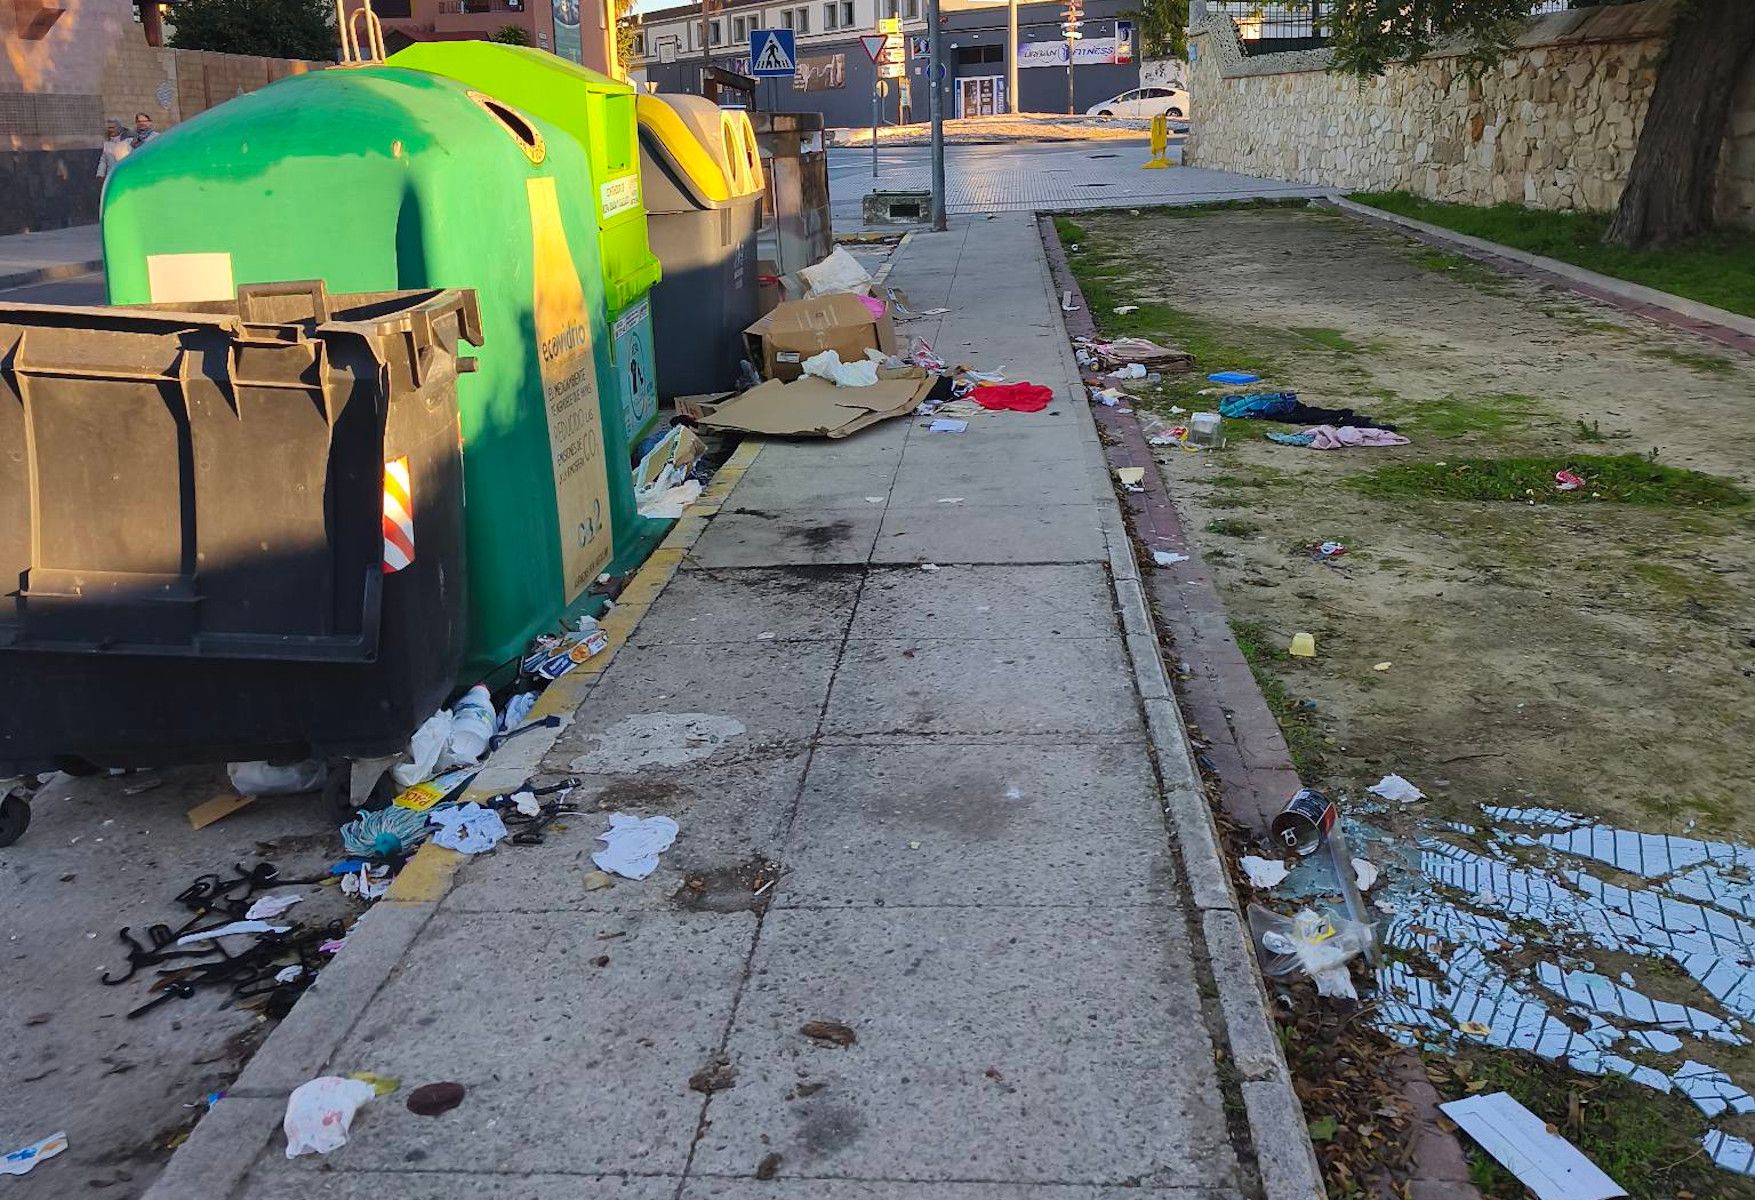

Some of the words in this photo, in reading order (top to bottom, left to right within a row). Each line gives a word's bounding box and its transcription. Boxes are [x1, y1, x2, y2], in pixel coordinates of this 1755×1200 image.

[1024, 47, 1058, 58] URBAN
[1073, 46, 1114, 57] FITNESS
[542, 319, 586, 362] ecovidrio
